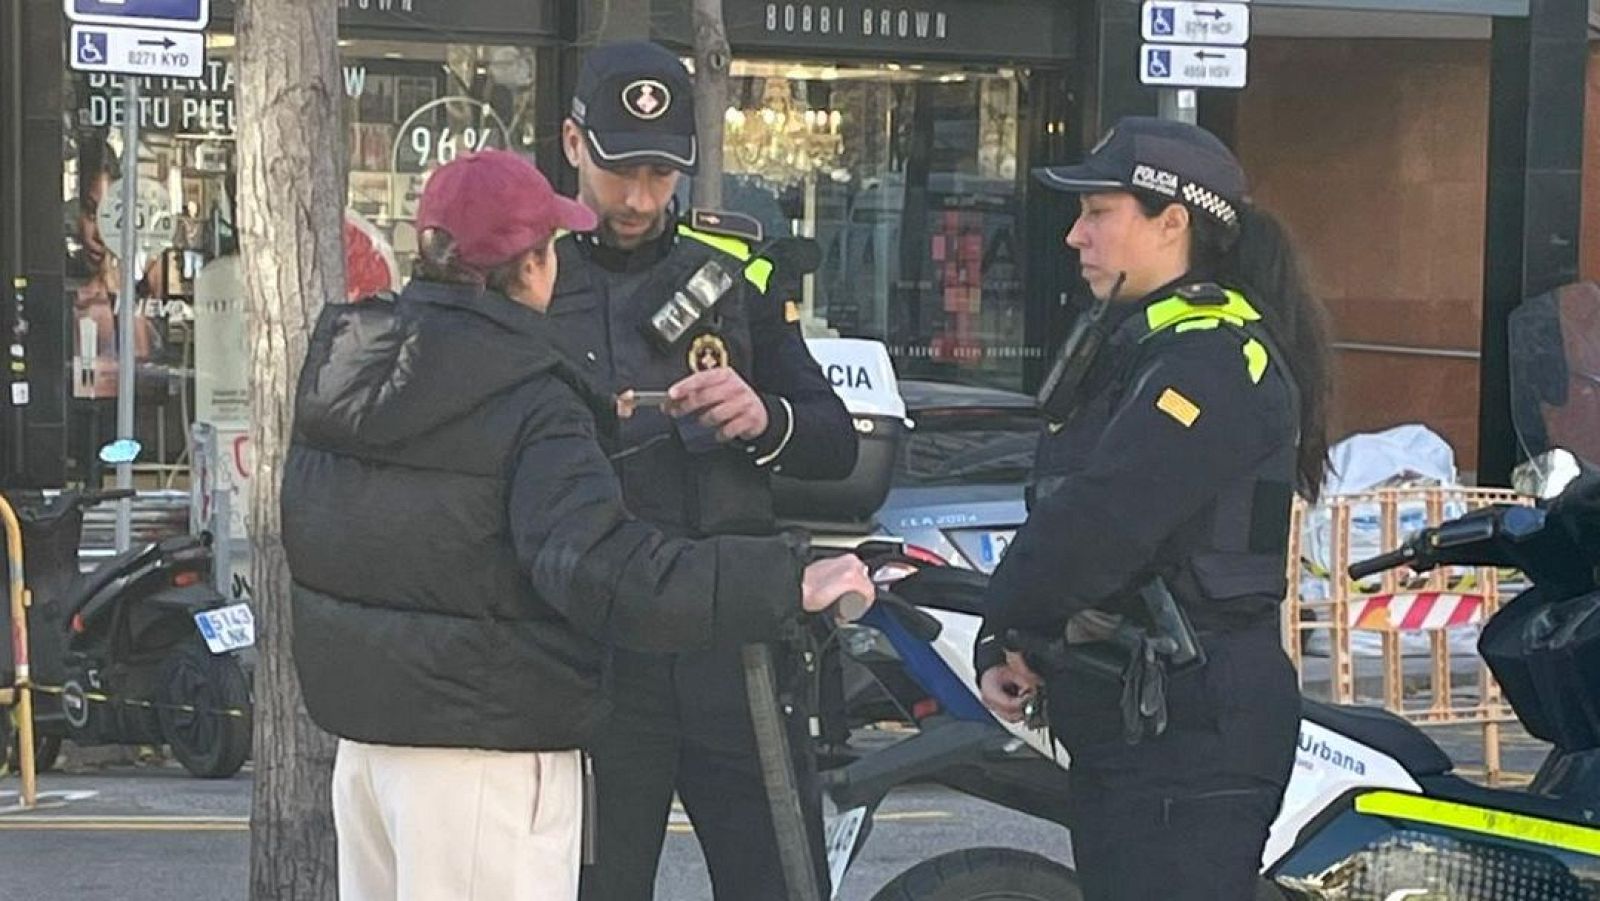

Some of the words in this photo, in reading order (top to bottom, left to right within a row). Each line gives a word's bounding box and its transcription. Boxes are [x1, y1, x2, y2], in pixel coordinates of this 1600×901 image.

[766, 3, 843, 34] BOBBI
[863, 8, 946, 38] BROWN
[161, 52, 189, 67] KYD
[90, 95, 125, 127] DE
[137, 97, 170, 128] TU
[1299, 731, 1366, 775] Urbana
